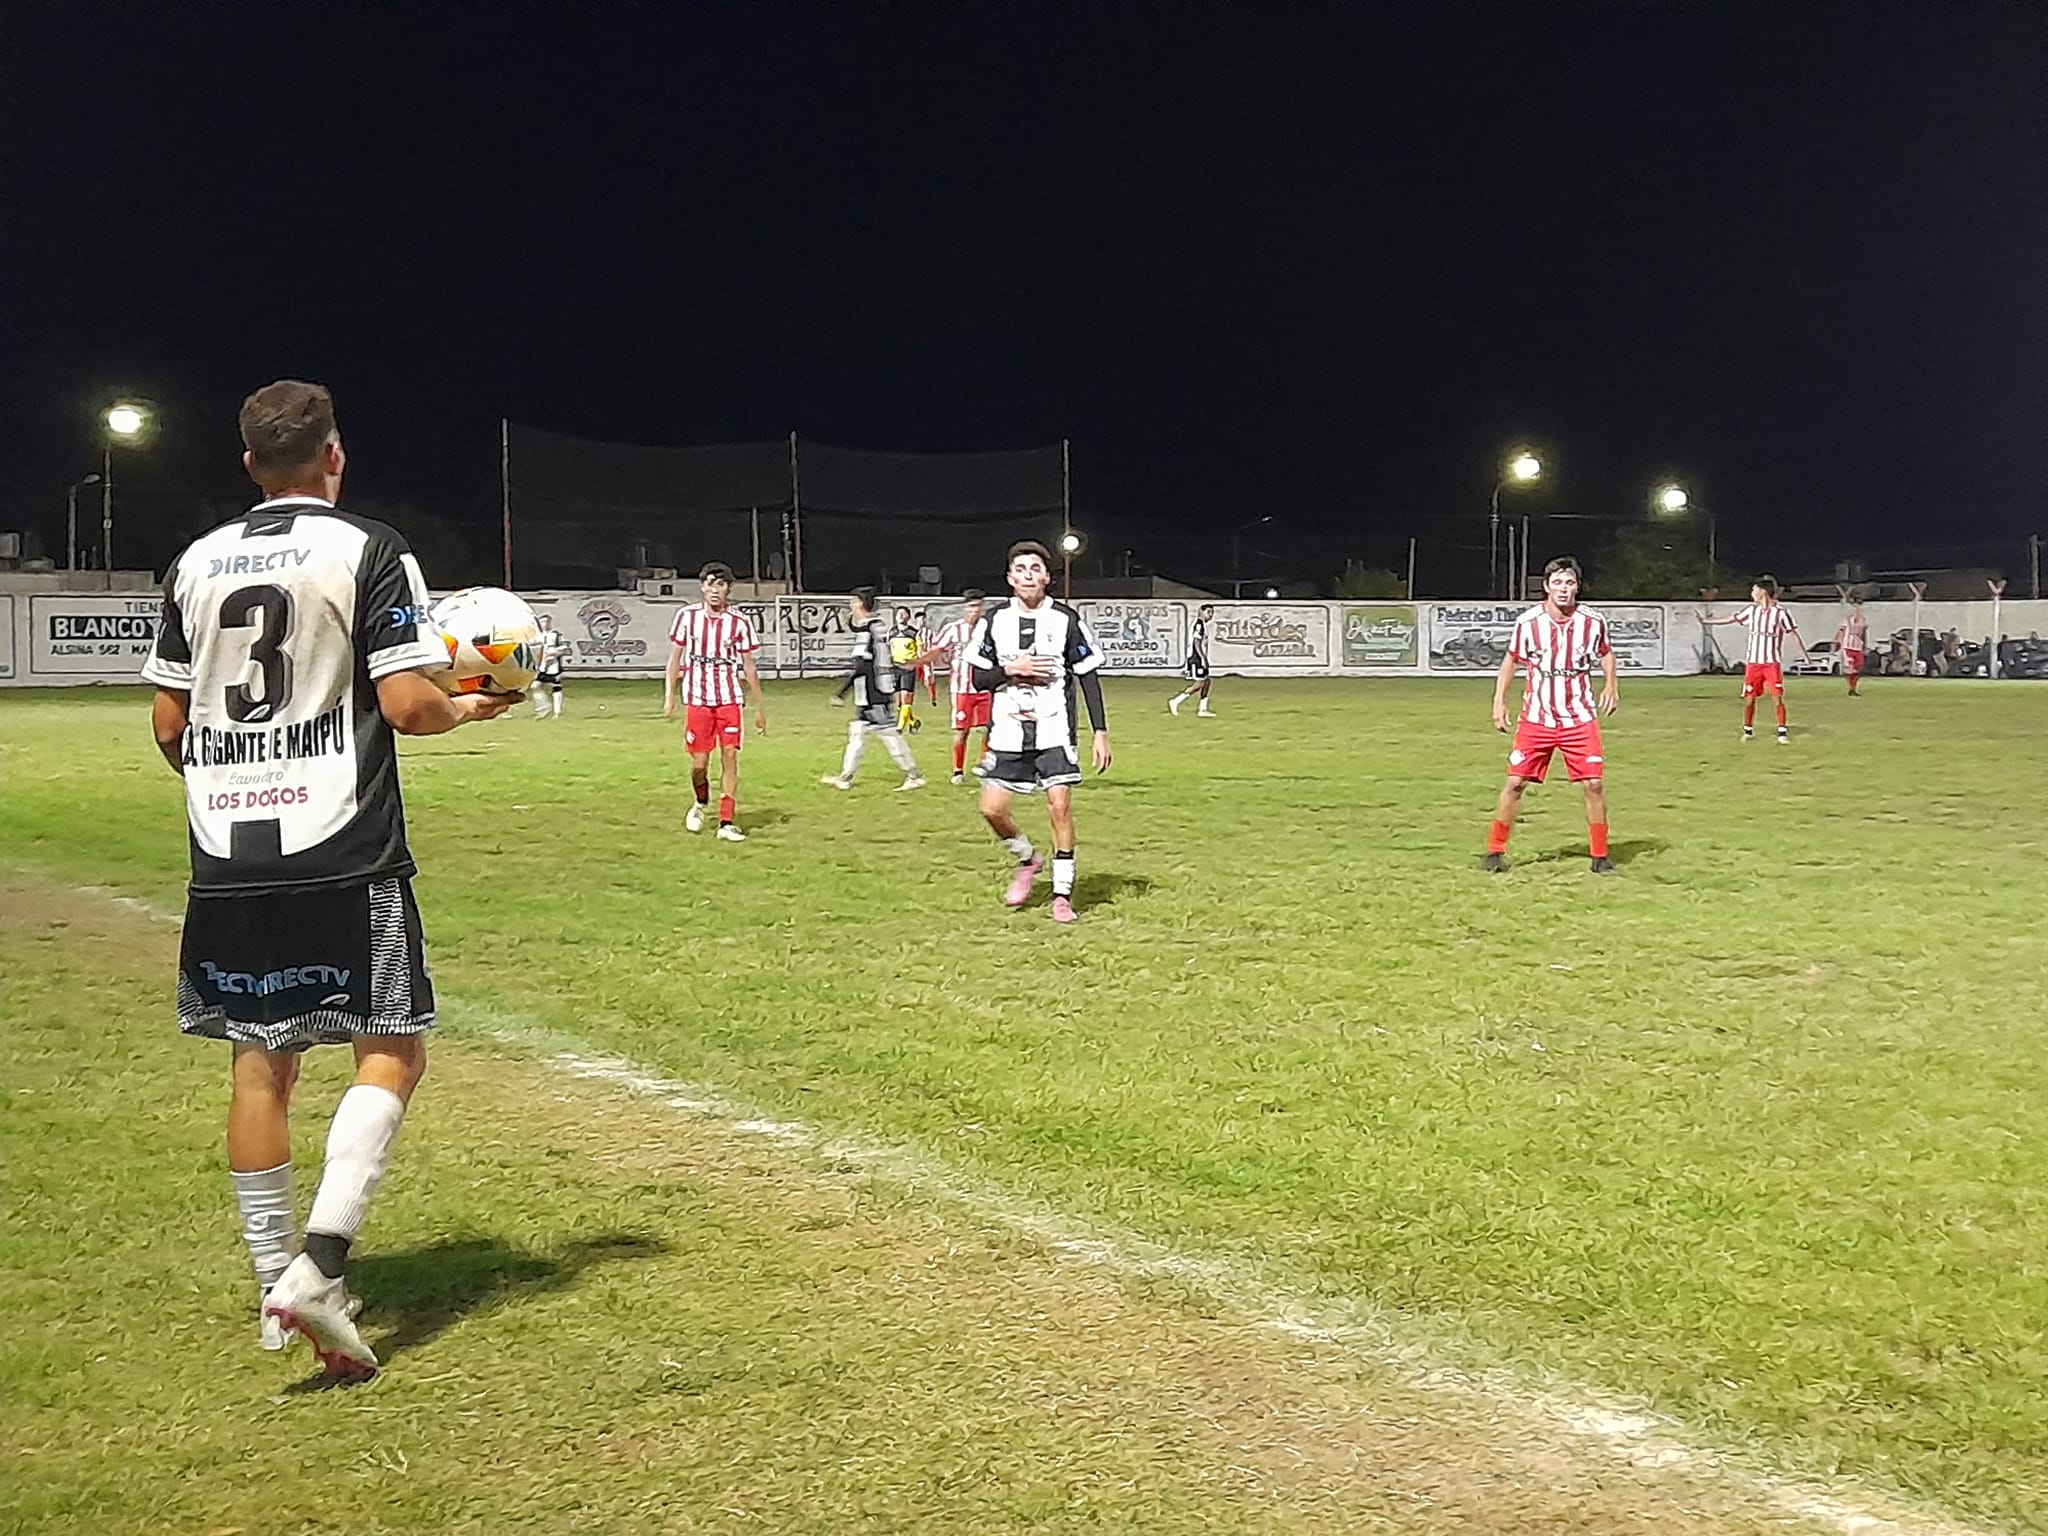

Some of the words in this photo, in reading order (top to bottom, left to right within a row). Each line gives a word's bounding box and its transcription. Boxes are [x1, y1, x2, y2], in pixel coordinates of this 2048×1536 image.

[207, 548, 312, 578] DIRECTV
[219, 583, 295, 724] 3
[789, 638, 826, 651] DSCO
[1102, 641, 1159, 651] LAVADERO
[286, 694, 345, 760] MAIPÚ
[208, 792, 240, 811] LOS
[245, 786, 309, 808] DOGOS
